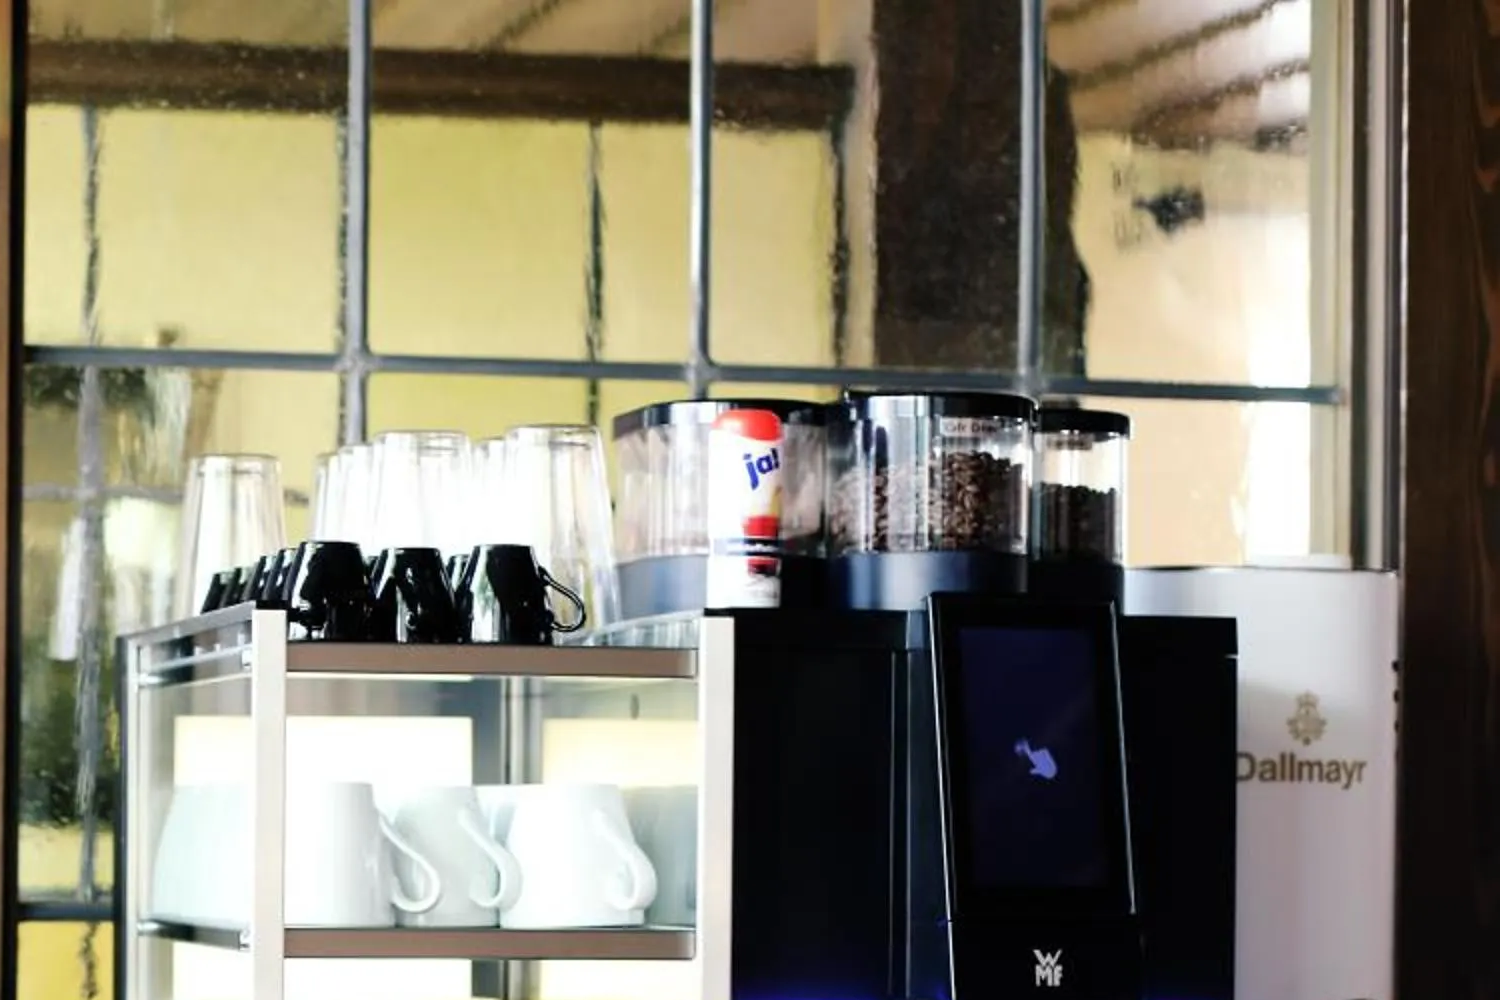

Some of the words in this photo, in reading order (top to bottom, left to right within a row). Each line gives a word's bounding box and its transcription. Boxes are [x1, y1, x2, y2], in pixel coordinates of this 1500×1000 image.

[743, 448, 780, 491] ja!
[1236, 751, 1367, 791] Dallmayr
[1032, 948, 1063, 987] WMF
